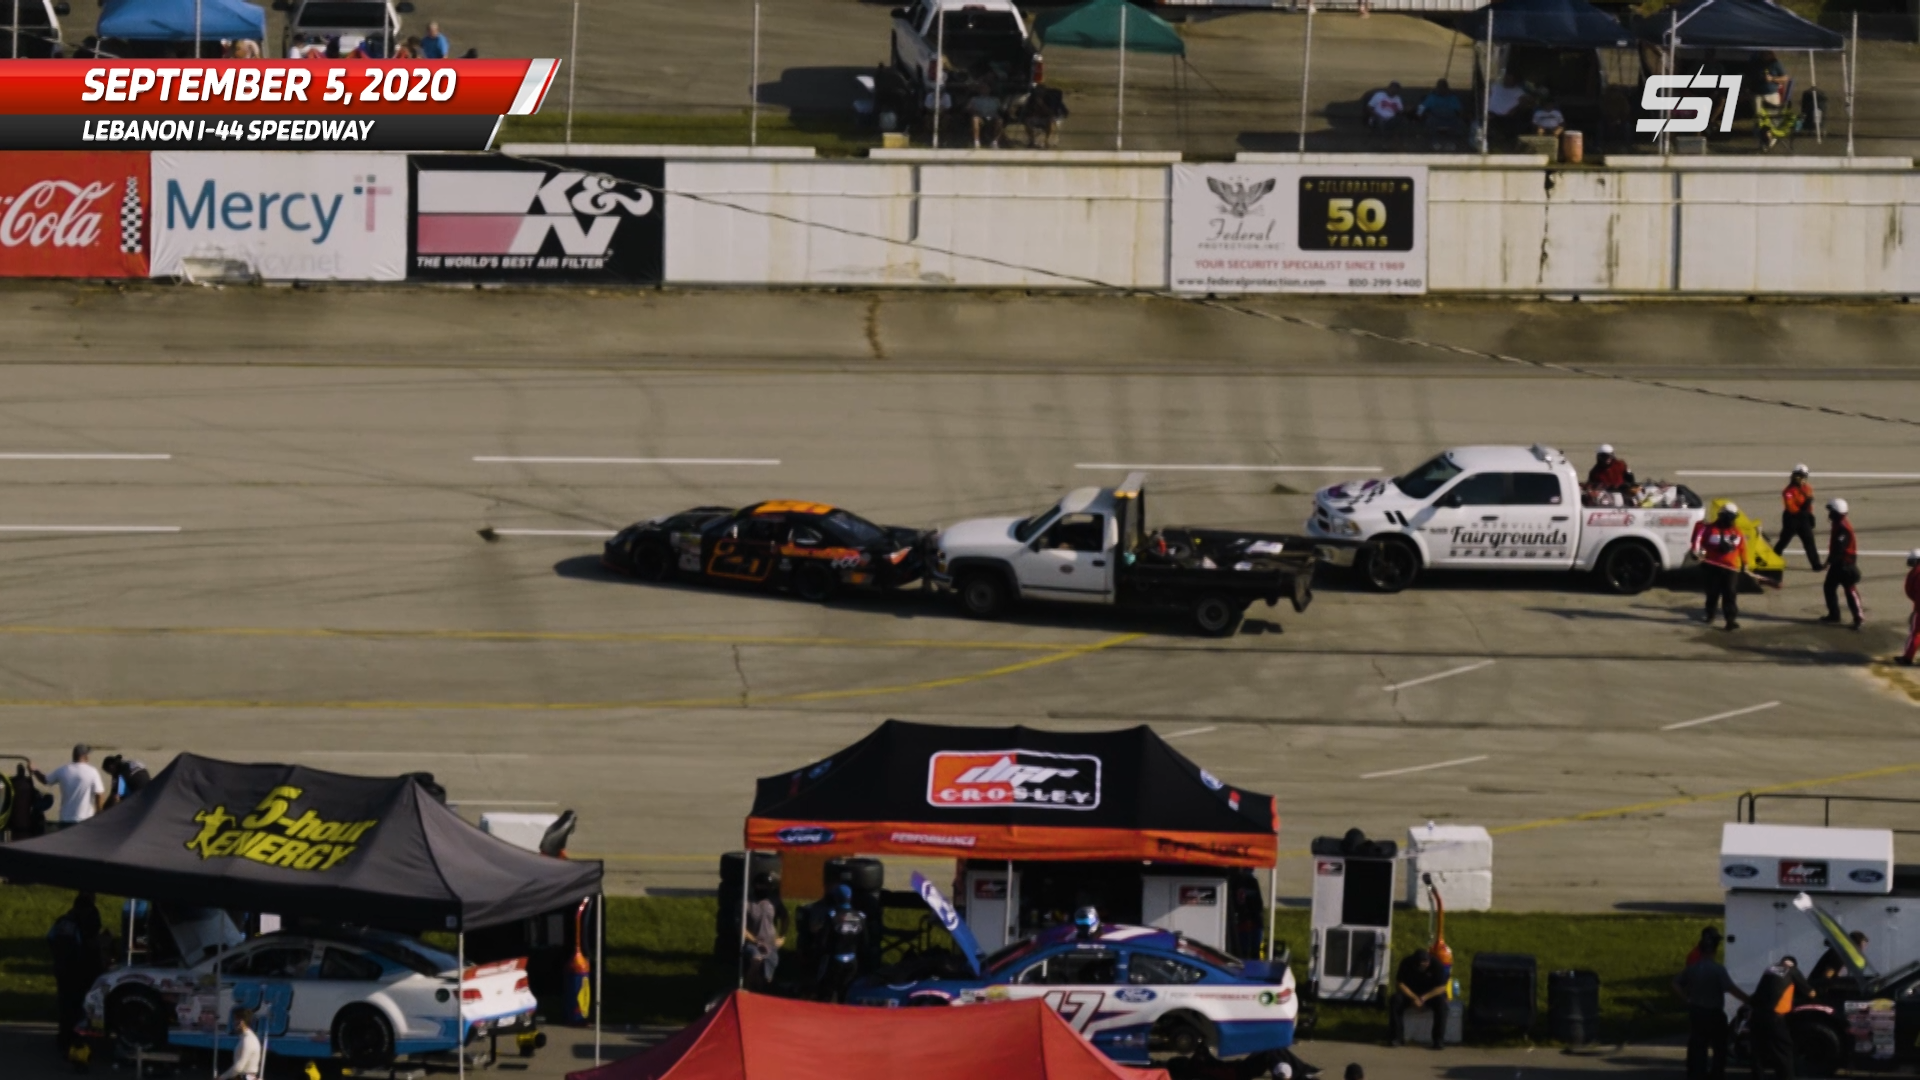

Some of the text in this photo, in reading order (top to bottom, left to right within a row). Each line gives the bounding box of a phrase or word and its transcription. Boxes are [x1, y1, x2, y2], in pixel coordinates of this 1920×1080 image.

[1318, 181, 1395, 193] CELEBRATING
[167, 179, 344, 245] Mercy
[1326, 198, 1387, 232] 50
[1205, 218, 1276, 241] Federal
[1327, 234, 1389, 248] YEARS
[416, 256, 605, 269] THE WORLD'S BEST AIR FILTER
[1195, 260, 1225, 270] YOUR
[1227, 260, 1278, 270] SECURITY
[1282, 260, 1342, 271] SPECIALIST
[1345, 261, 1375, 271] SINCE
[1176, 276, 1327, 289] www.federalprotection.com
[1450, 526, 1568, 549] Fairgrounds
[939, 787, 1092, 804] CROSLEY
[242, 785, 379, 843] 5-hour
[890, 832, 977, 848] PERFORMANCE
[209, 830, 357, 871] ENERGY
[1043, 990, 1106, 1041] 17
